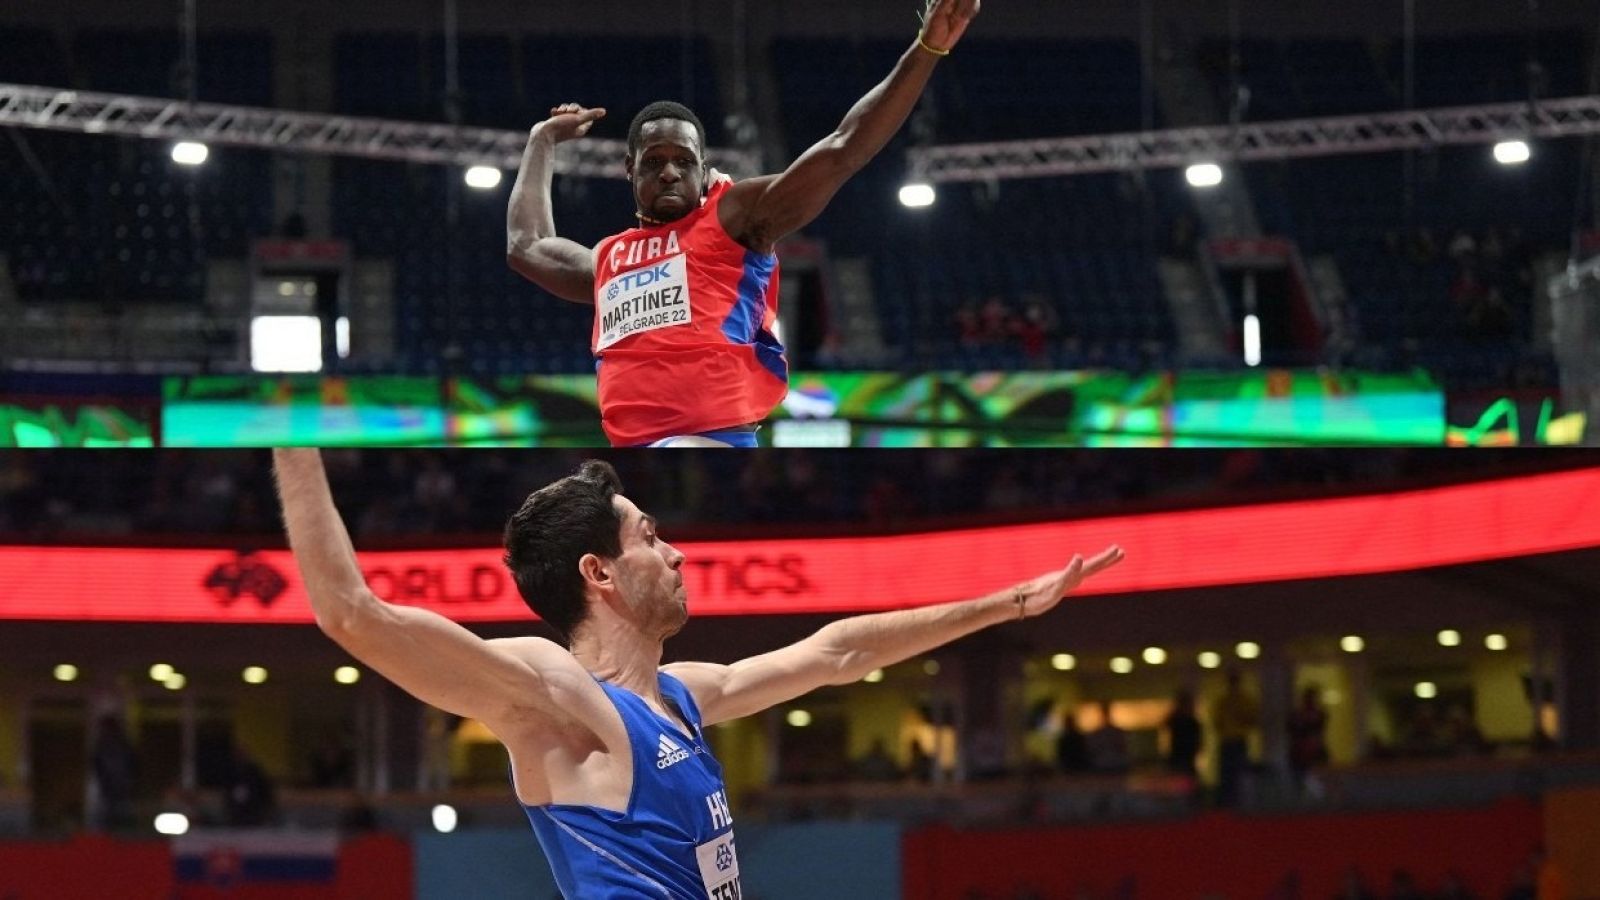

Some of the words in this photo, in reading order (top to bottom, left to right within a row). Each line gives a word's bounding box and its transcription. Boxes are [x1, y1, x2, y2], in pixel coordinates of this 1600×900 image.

[610, 230, 680, 273] CUBA
[619, 262, 671, 290] TDK
[602, 285, 684, 334] MARTÍNEZ
[671, 309, 687, 322] 22
[364, 564, 506, 605] ORLD
[656, 749, 689, 769] adidas
